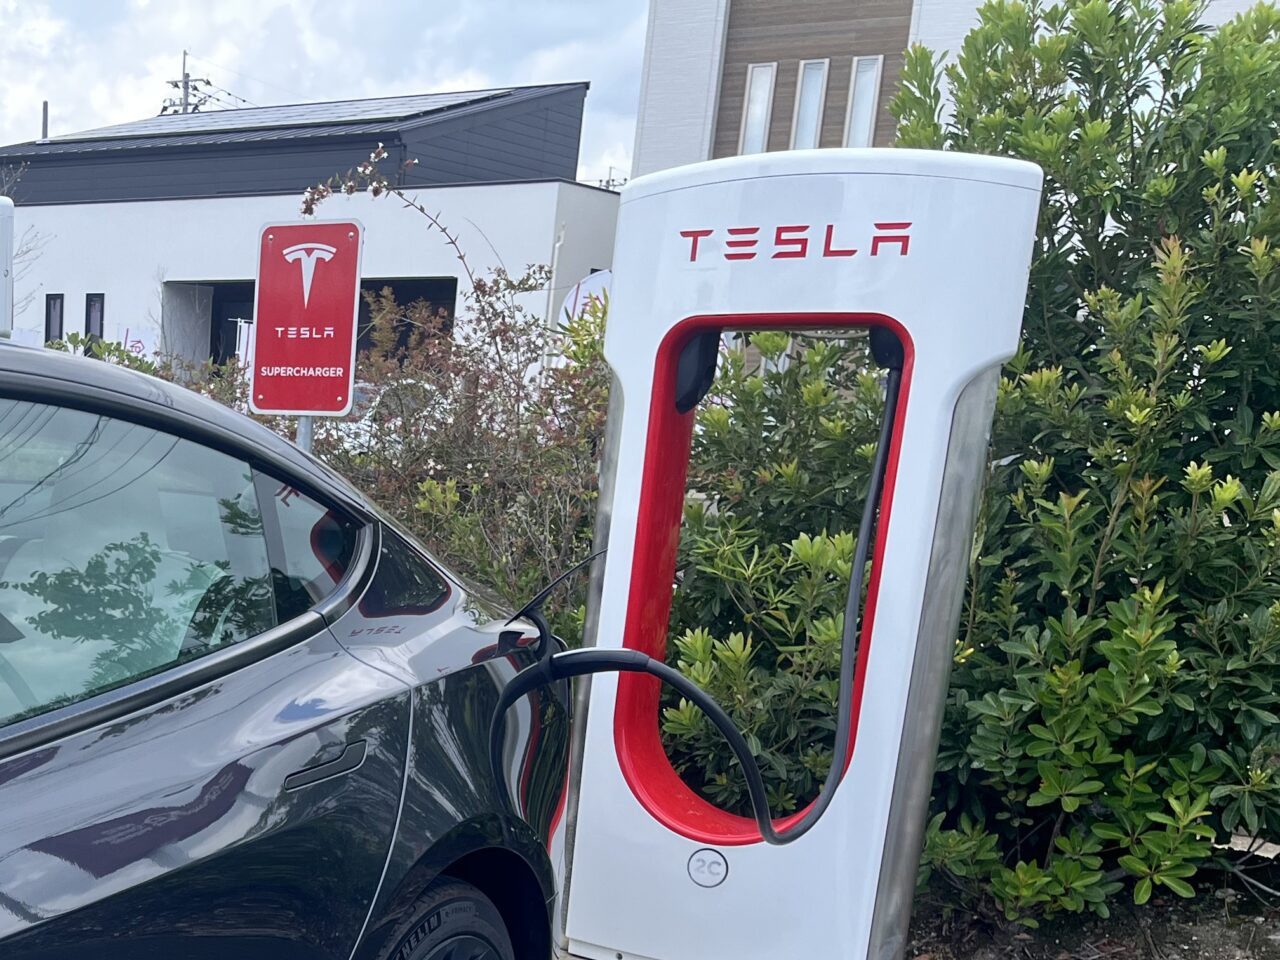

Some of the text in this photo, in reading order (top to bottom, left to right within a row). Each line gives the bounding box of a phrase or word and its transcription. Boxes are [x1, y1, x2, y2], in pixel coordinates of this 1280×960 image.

[679, 221, 912, 262] TESLA
[275, 327, 334, 338] TESLA
[261, 366, 344, 378] SUPERCHARGER
[694, 858, 722, 876] 2C
